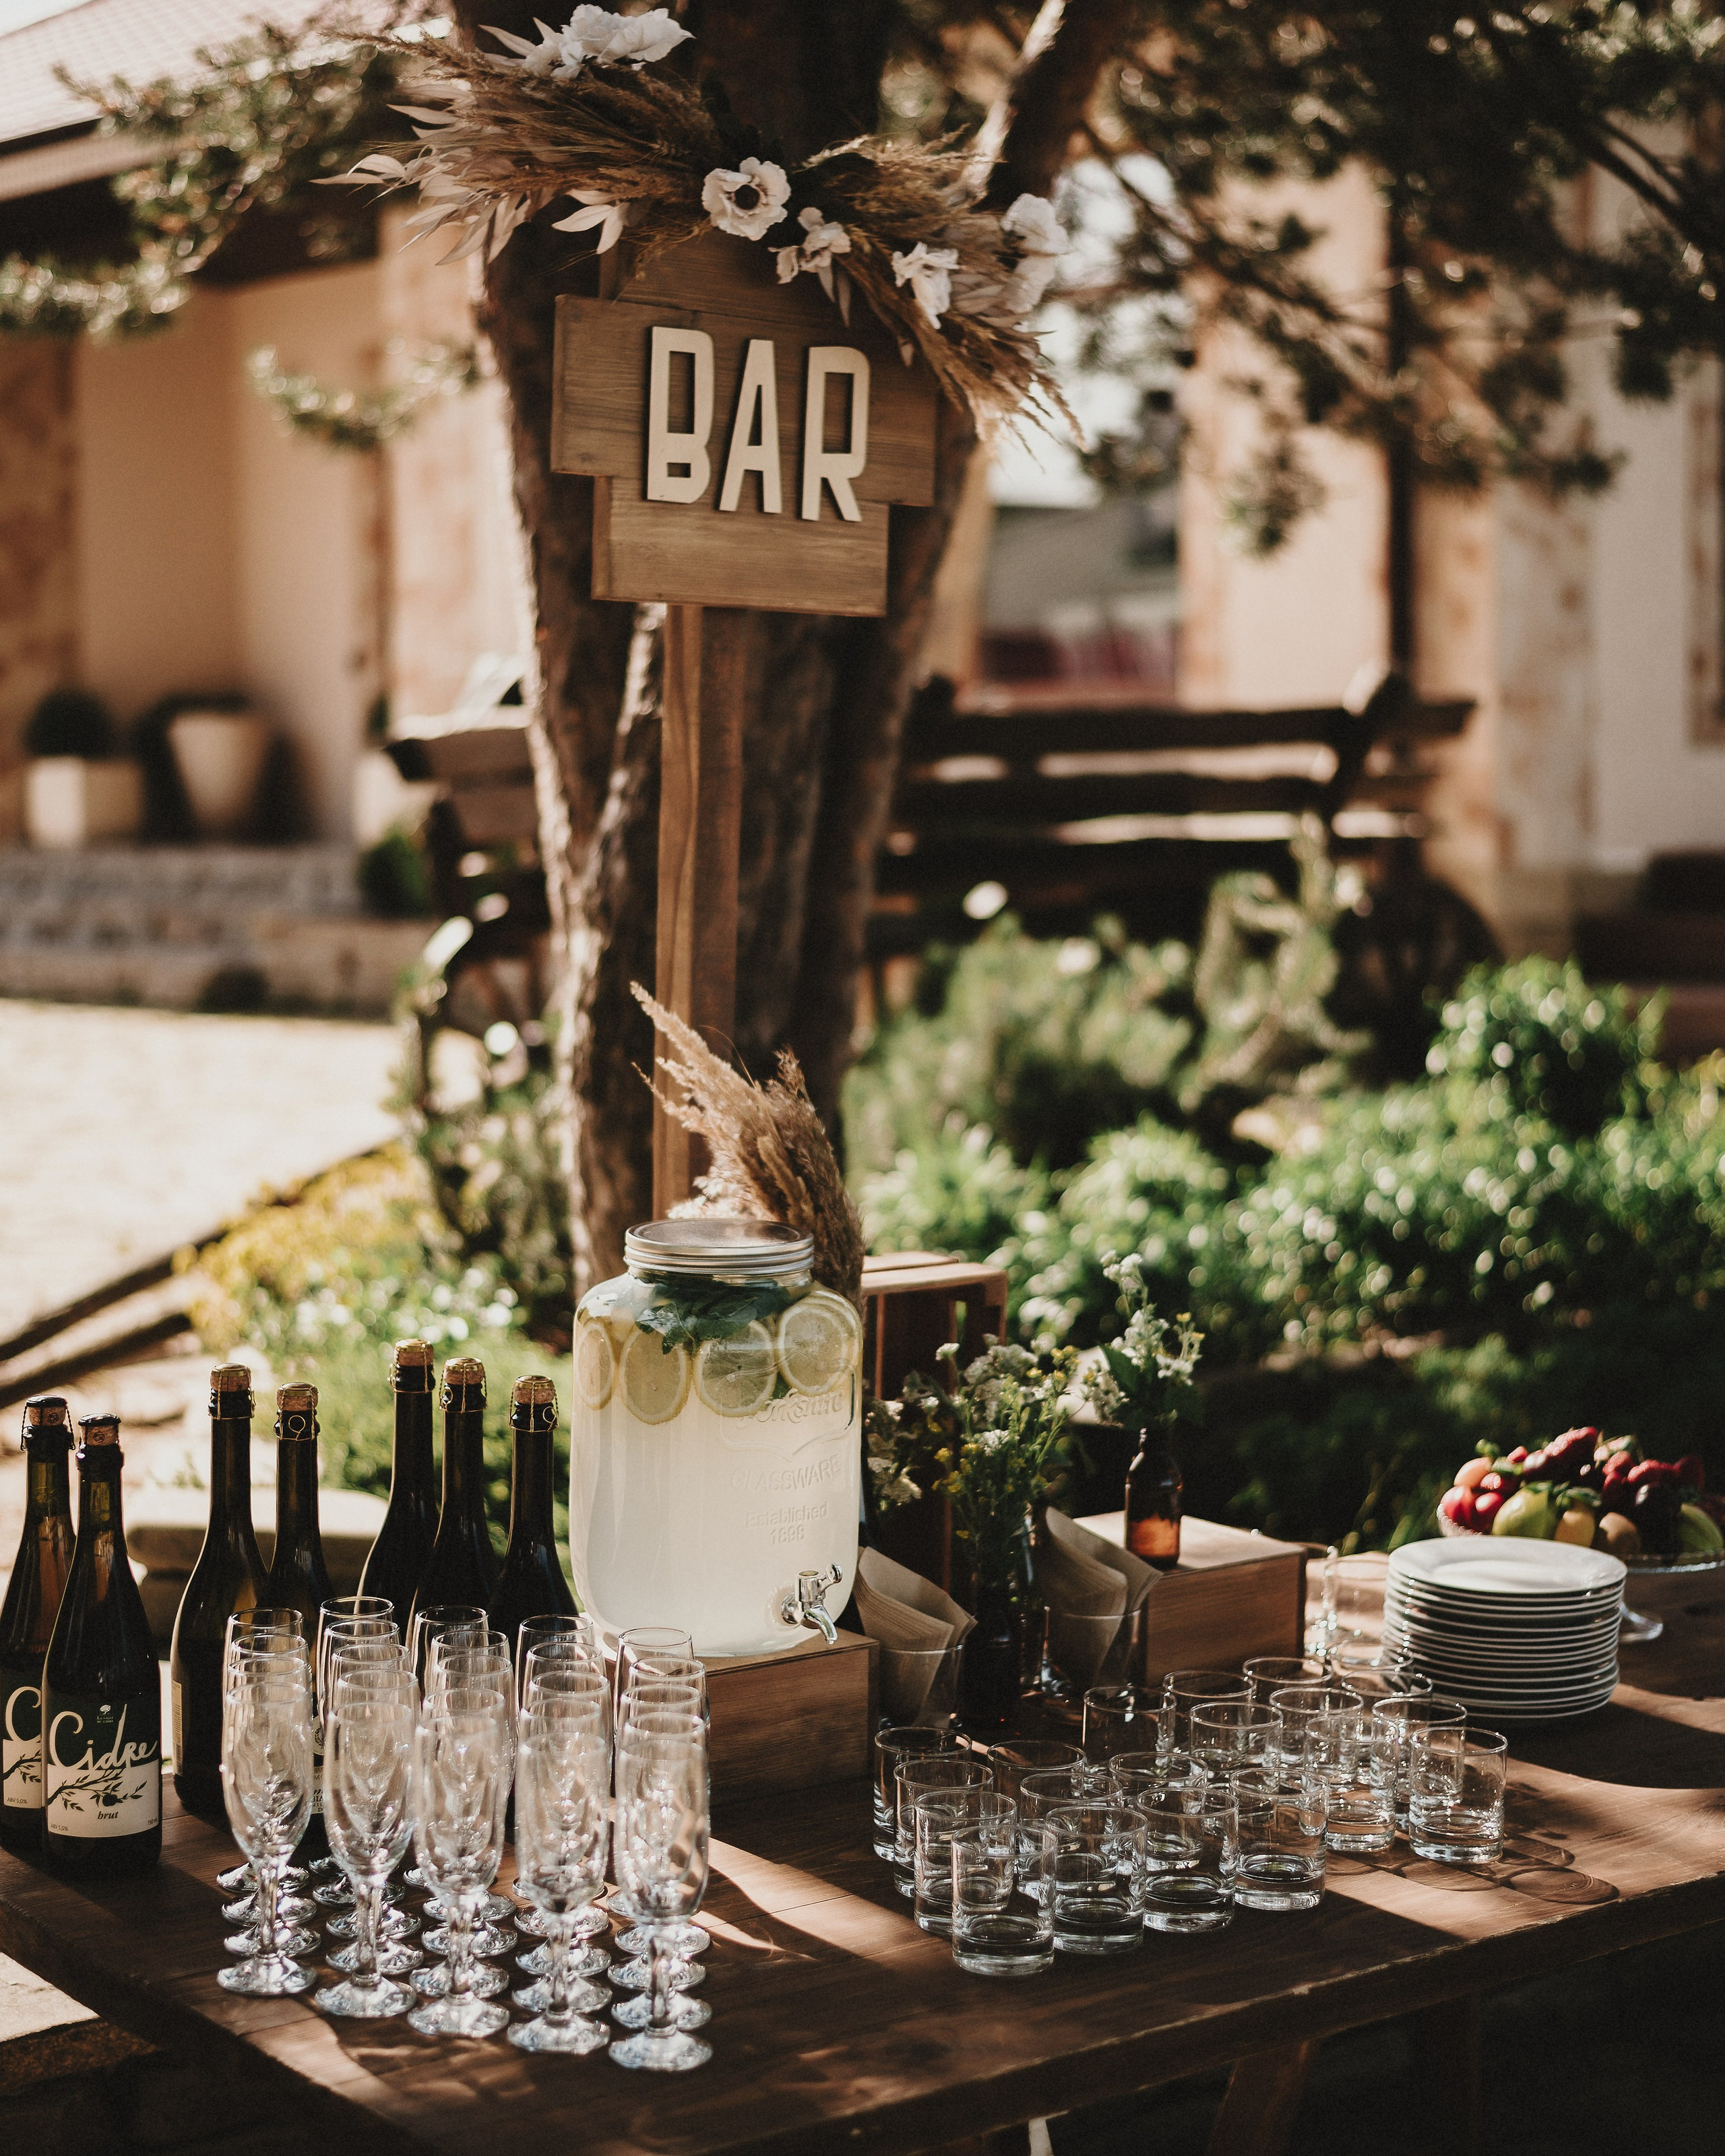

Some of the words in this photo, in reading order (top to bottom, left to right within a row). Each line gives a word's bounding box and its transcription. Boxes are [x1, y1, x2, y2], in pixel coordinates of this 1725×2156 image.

[646, 326, 871, 523] BAR
[730, 1453, 842, 1492] GLASSWARE
[745, 1500, 829, 1528] Established
[49, 1703, 158, 1770] Cidre
[97, 1810, 119, 1820] brut
